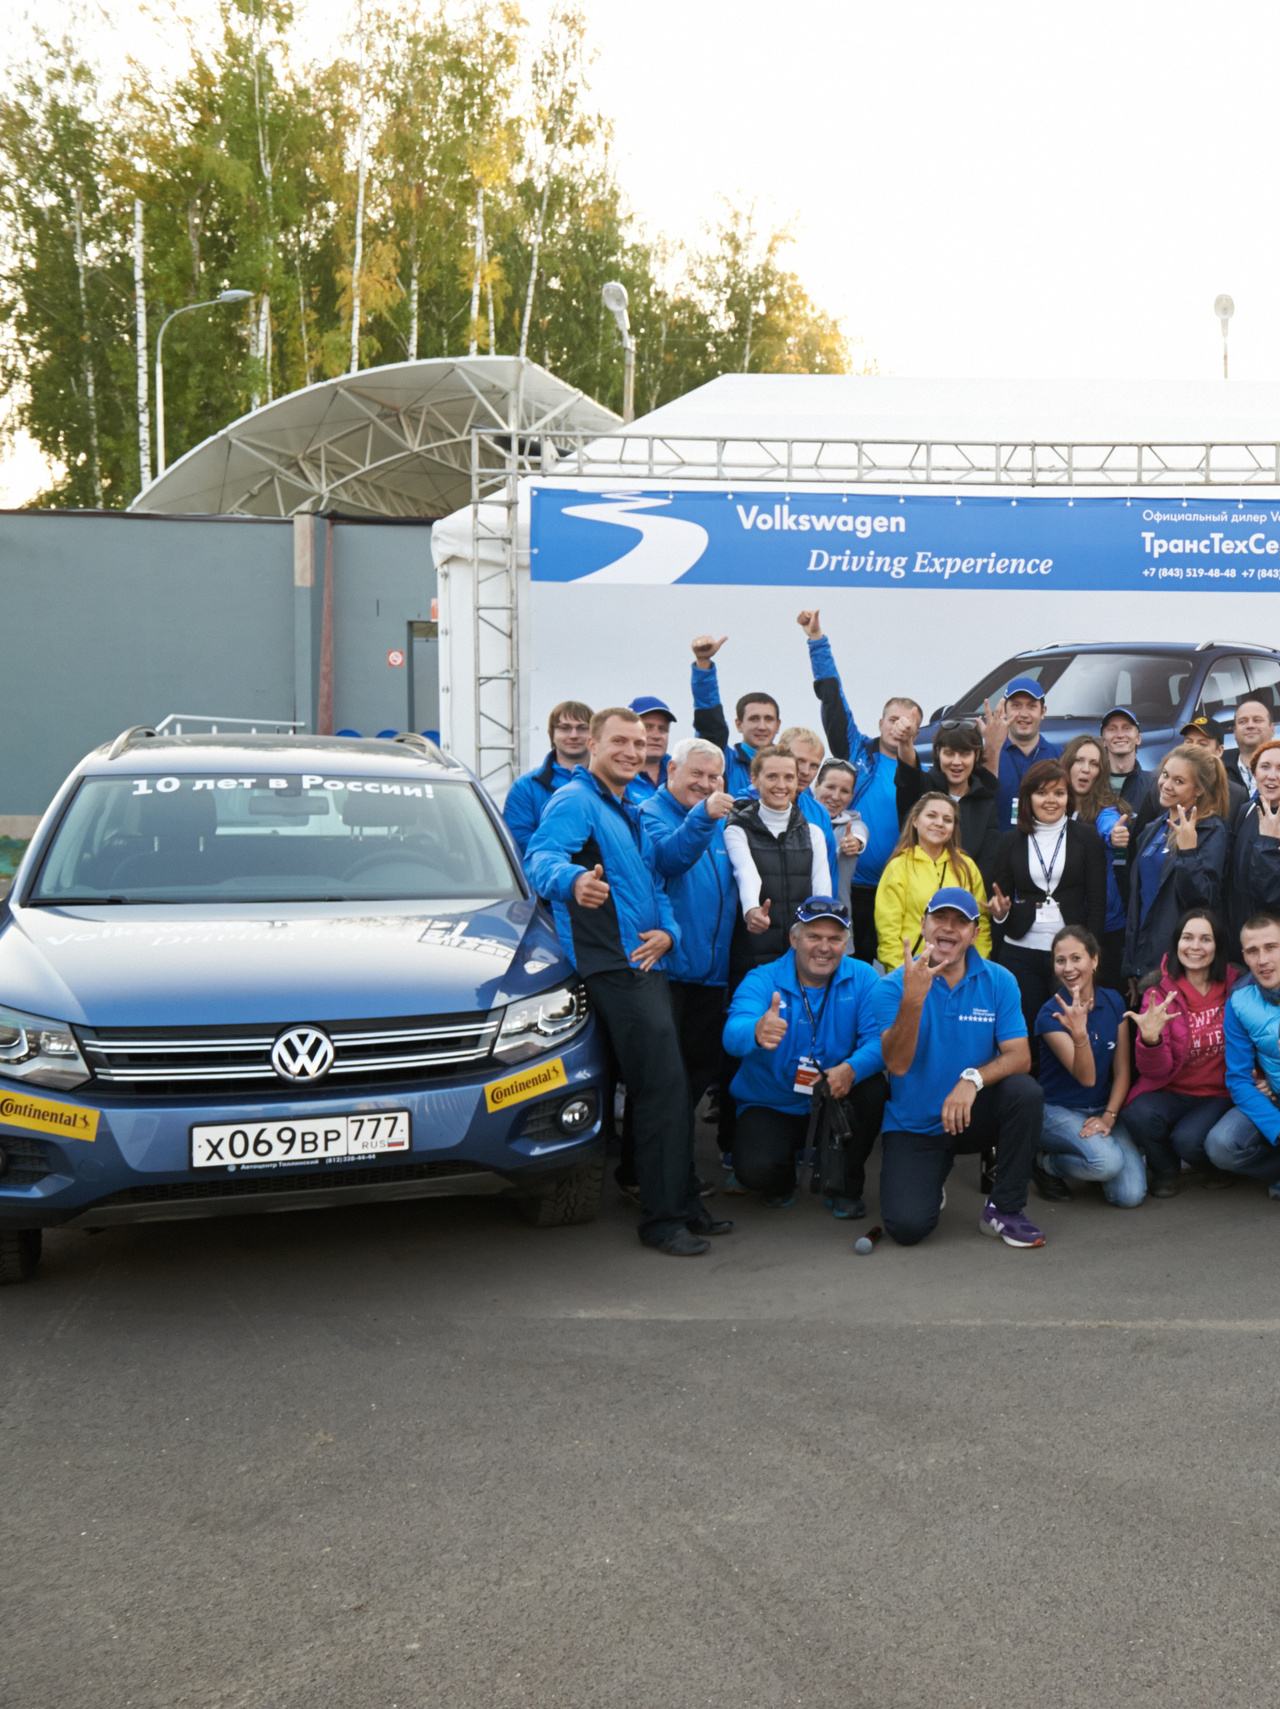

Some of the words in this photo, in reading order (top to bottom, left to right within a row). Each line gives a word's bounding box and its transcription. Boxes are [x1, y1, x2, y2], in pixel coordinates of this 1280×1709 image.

[736, 504, 906, 538] Volkswagen
[1142, 509, 1228, 523] Официальный
[1231, 512, 1267, 525] дилер
[807, 549, 908, 578] Driving
[912, 551, 1053, 579] Experience
[1142, 568, 1156, 578] +7
[1158, 568, 1183, 580] (843)
[1185, 568, 1236, 578] 519-48-48
[1241, 569, 1255, 578] +7
[132, 777, 180, 796] 10
[192, 778, 256, 791] лет
[269, 778, 288, 789] в
[302, 774, 435, 799] России!
[491, 1068, 552, 1104] Continental
[0, 1098, 77, 1127] Continental
[350, 1116, 398, 1141] 777
[362, 1139, 386, 1149] RUS
